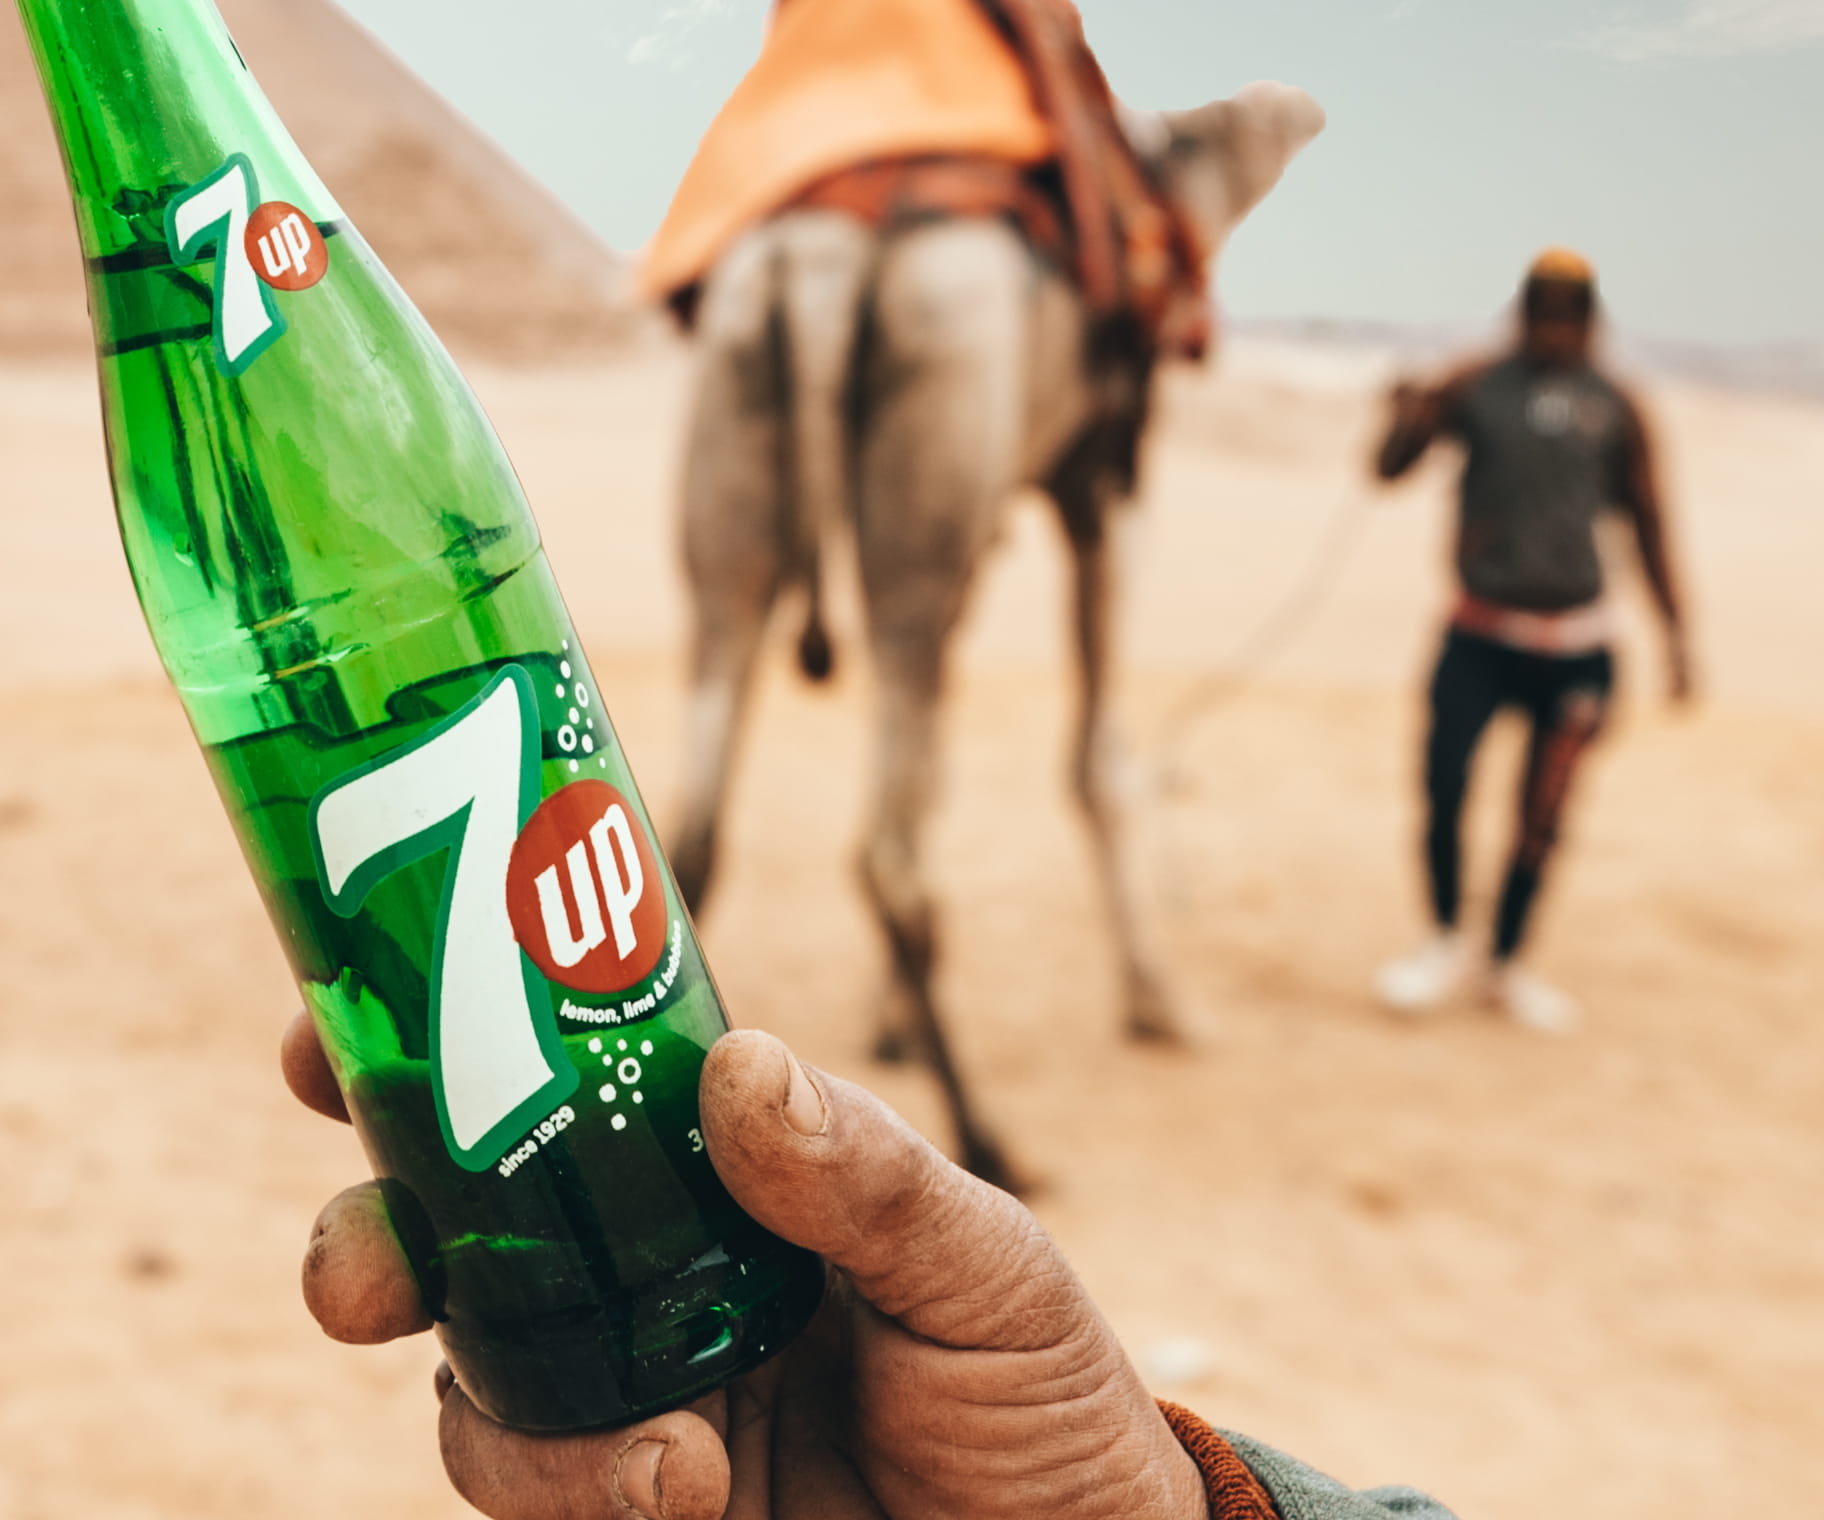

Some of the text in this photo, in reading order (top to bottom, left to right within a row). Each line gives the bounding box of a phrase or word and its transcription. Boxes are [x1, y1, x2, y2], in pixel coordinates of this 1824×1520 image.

[559, 998, 622, 1024] lemon,
[622, 993, 656, 1020] lime
[498, 1105, 576, 1178] since 1929
